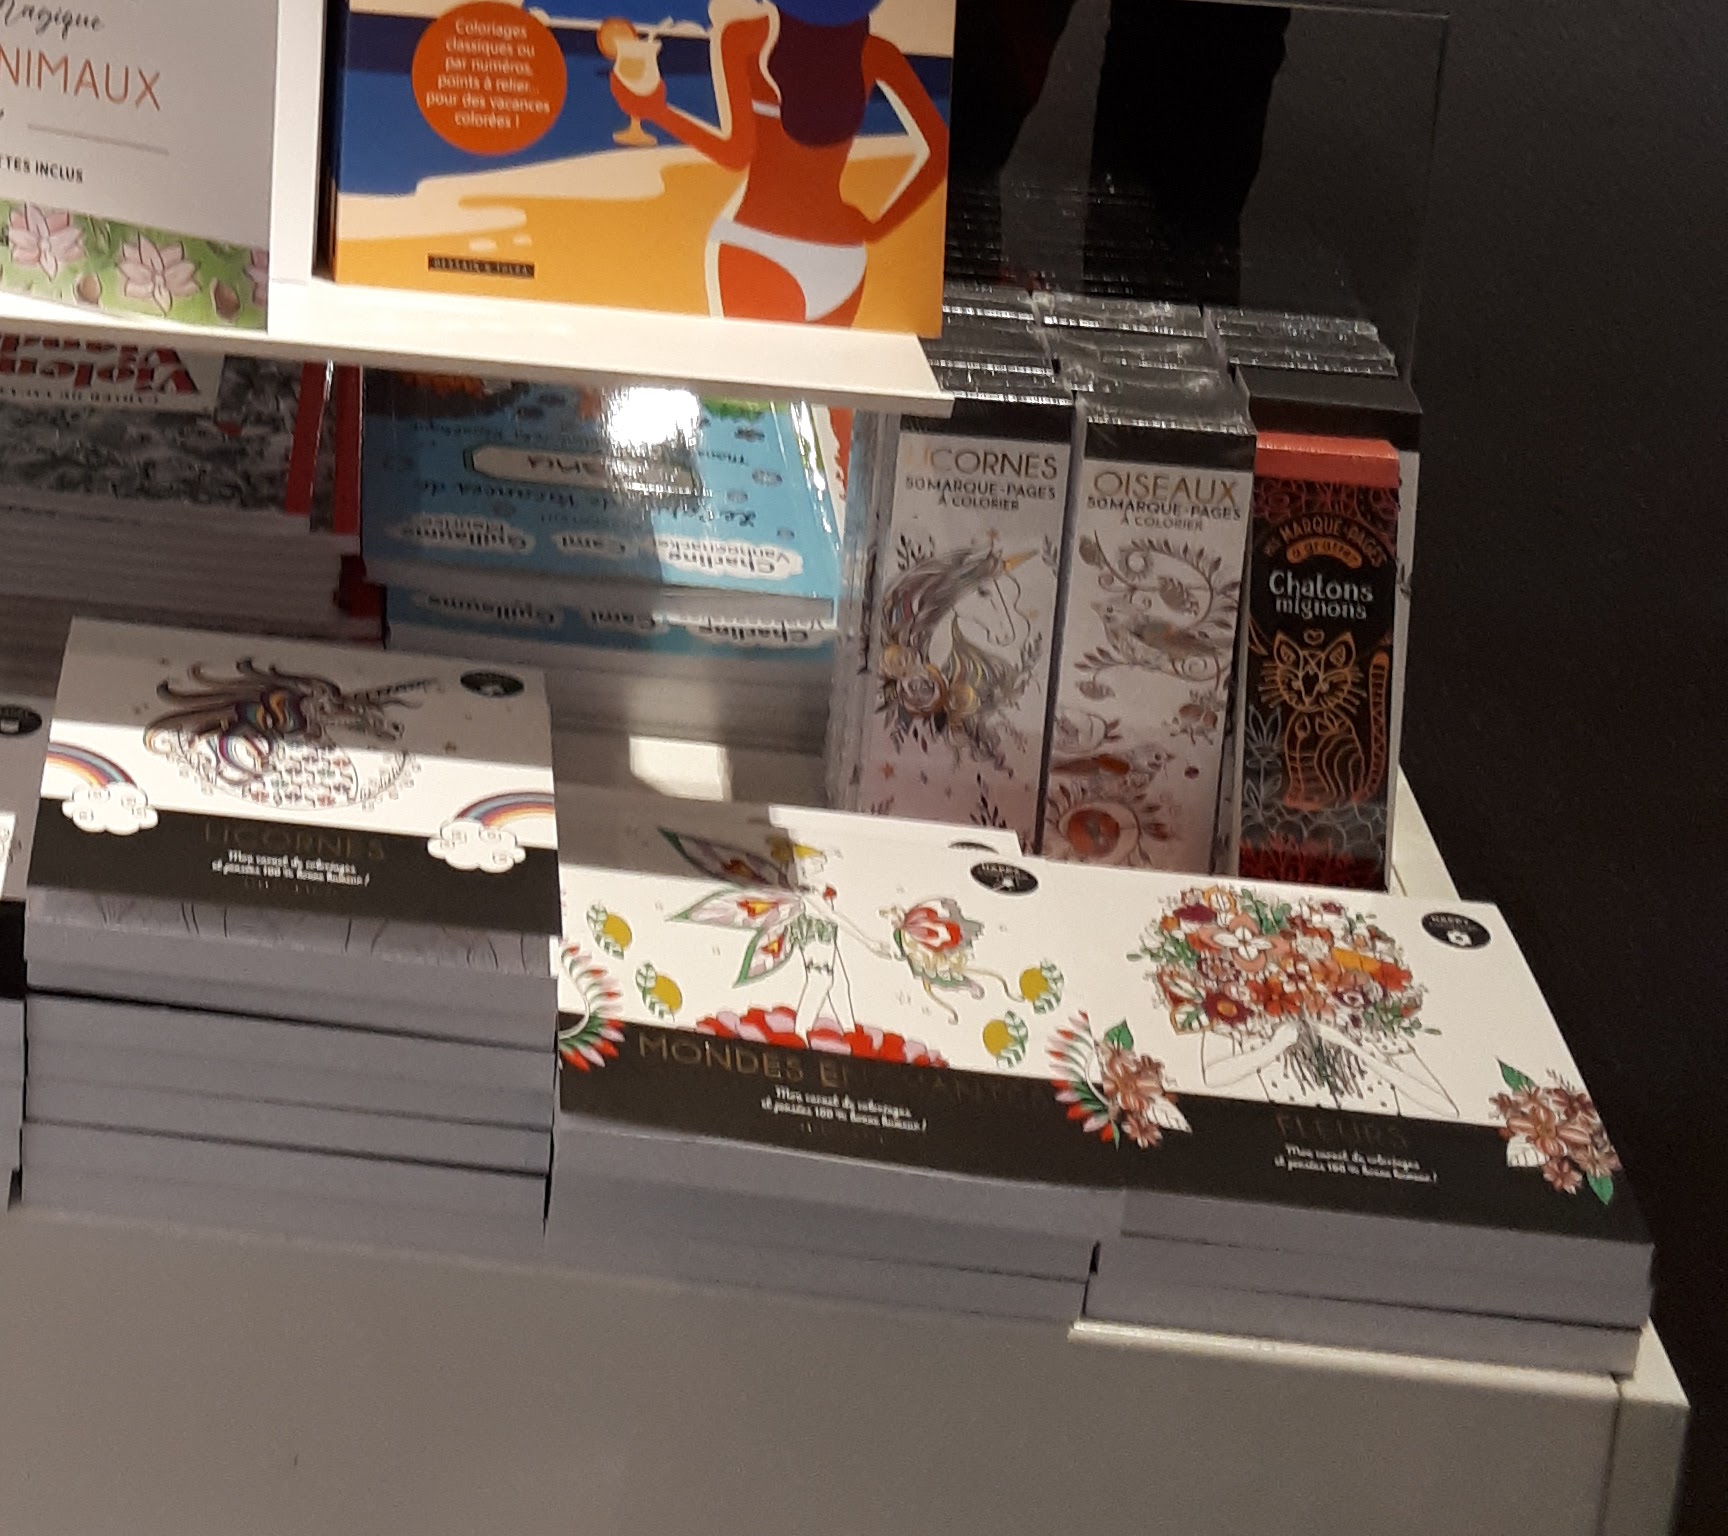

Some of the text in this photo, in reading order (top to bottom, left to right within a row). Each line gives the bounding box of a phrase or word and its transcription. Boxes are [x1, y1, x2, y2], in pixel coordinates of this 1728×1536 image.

[35, 161, 83, 184] INCLUS
[1093, 470, 1238, 507] OISEAUX
[639, 1035, 805, 1081] MONDES
